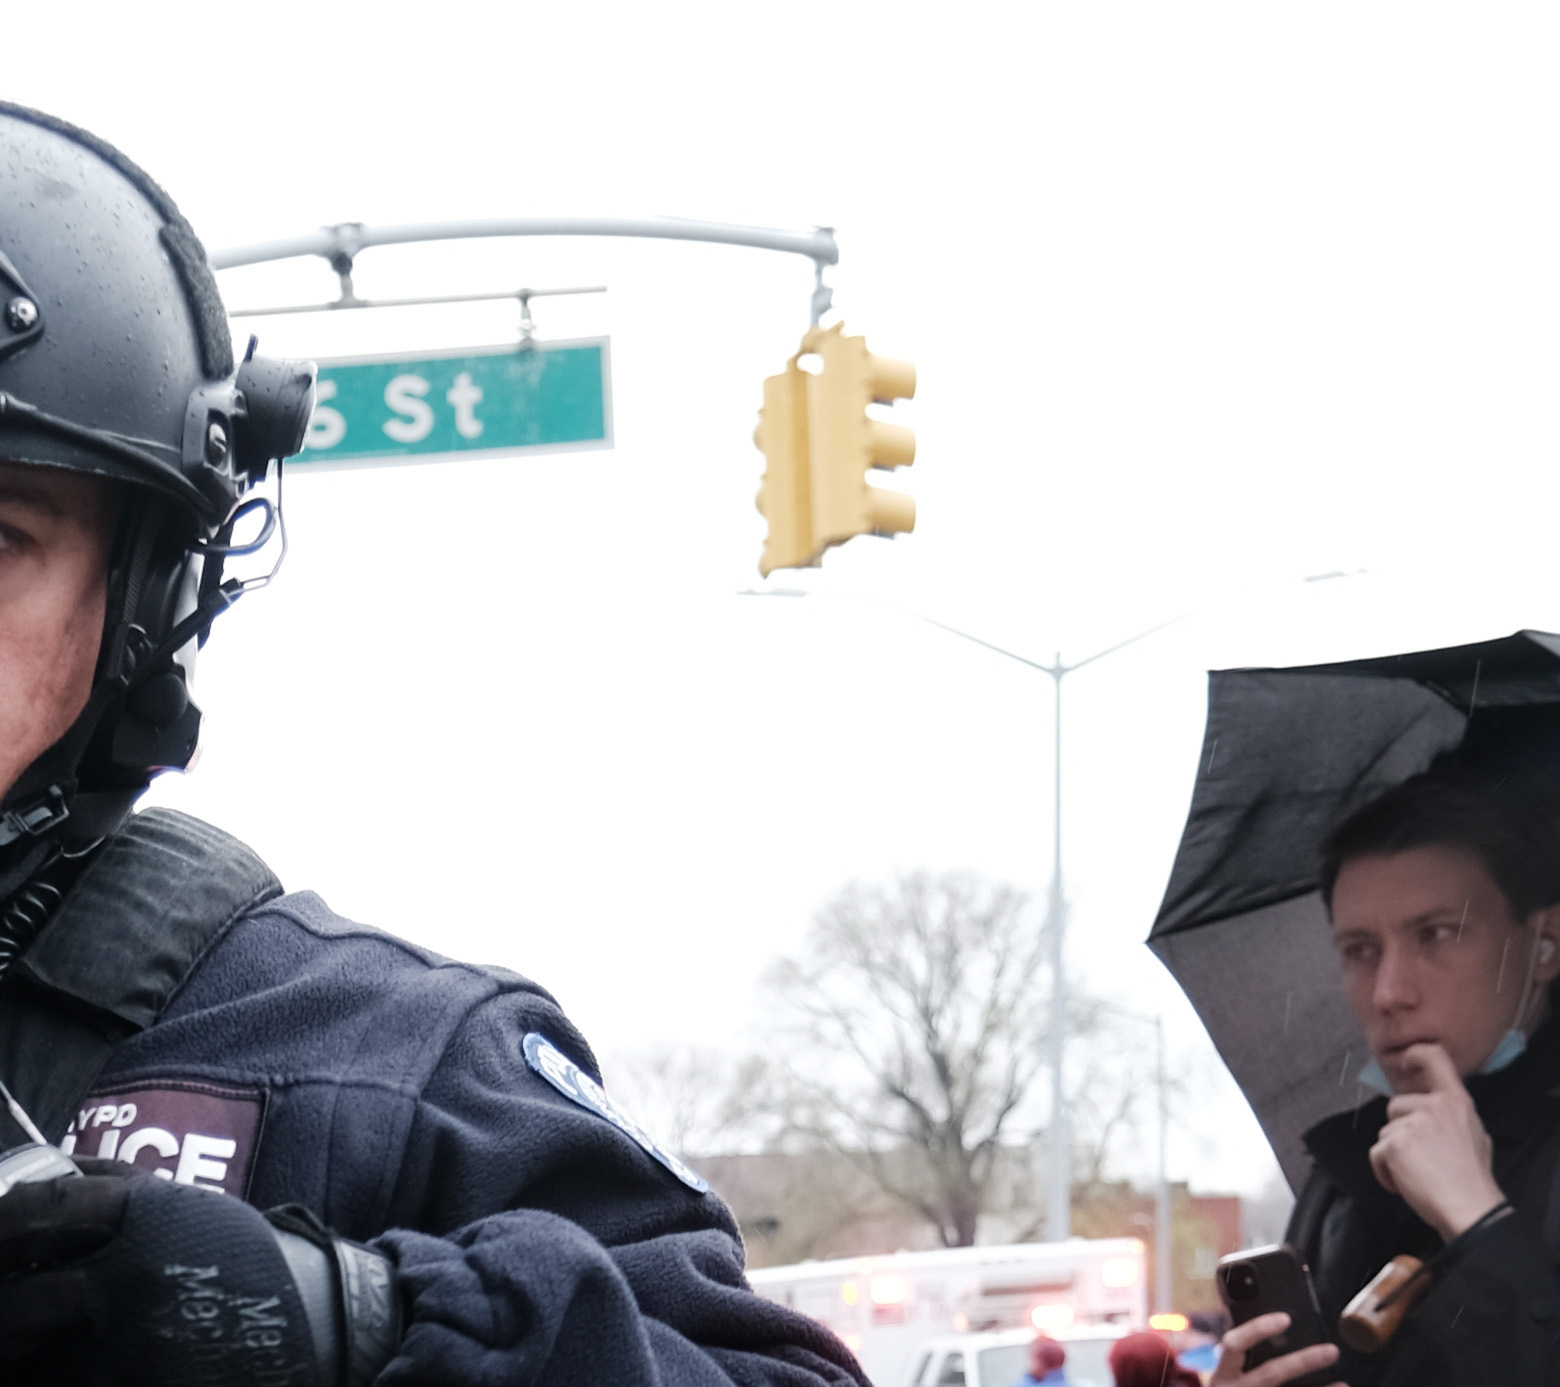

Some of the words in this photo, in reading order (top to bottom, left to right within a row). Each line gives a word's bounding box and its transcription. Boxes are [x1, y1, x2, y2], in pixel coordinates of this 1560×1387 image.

[304, 378, 347, 450] 6
[382, 372, 484, 443] St
[67, 1102, 138, 1133] YPD
